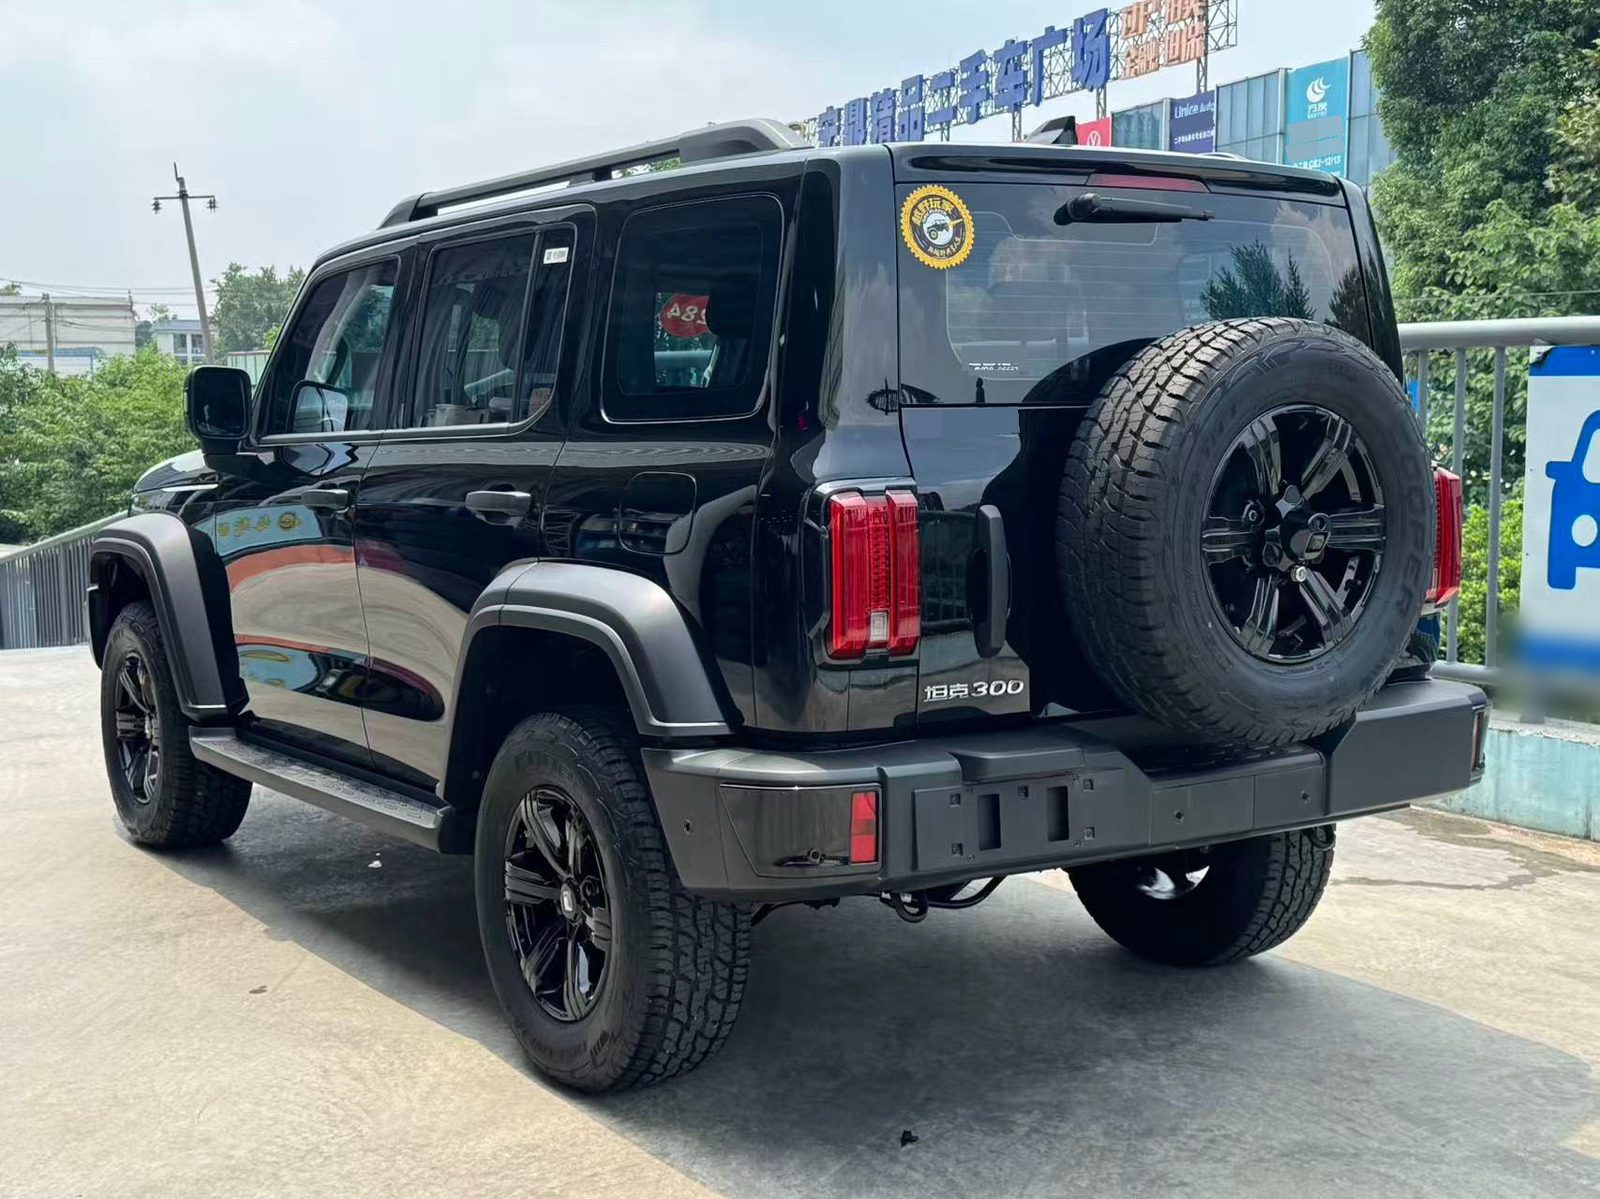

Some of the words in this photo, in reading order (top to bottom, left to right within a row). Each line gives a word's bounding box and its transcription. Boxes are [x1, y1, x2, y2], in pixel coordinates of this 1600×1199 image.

[911, 197, 955, 227] 越野玩家
[923, 679, 1024, 702] 坦克300
